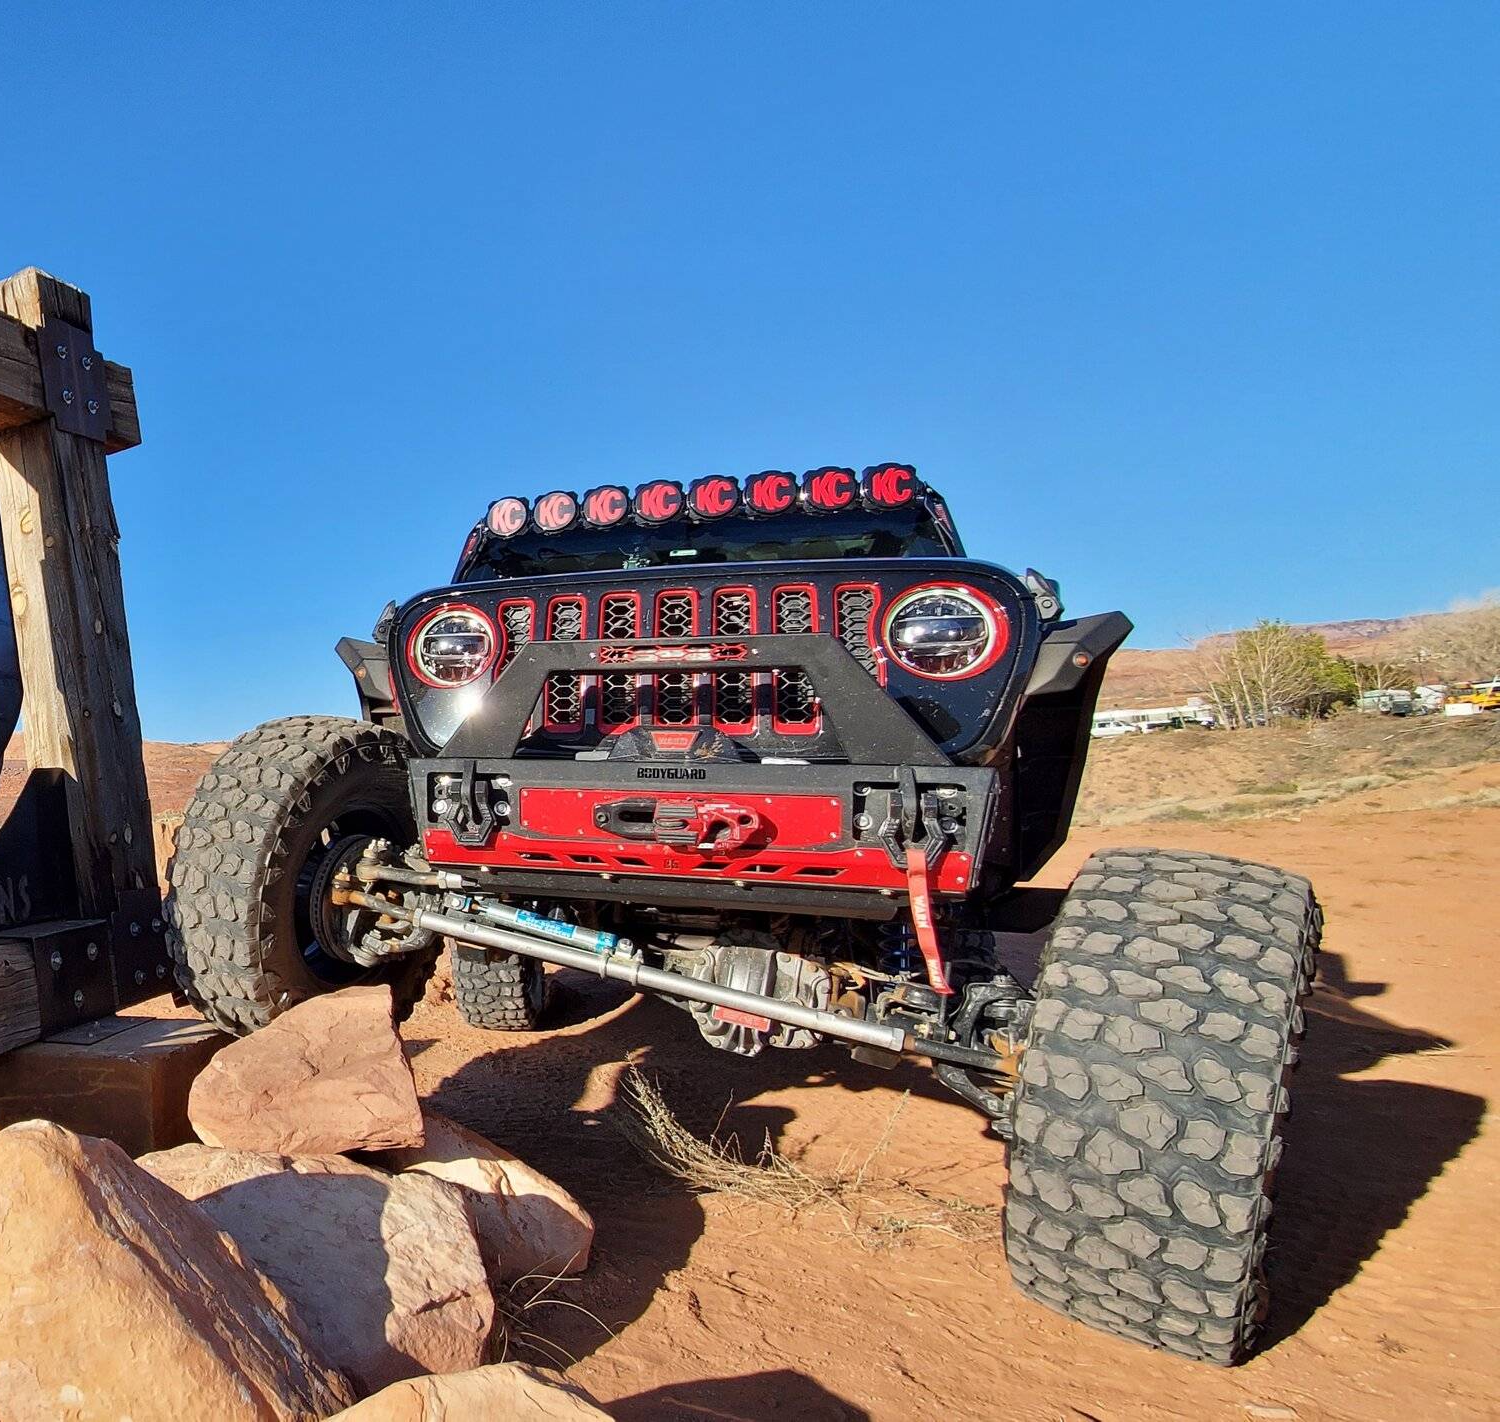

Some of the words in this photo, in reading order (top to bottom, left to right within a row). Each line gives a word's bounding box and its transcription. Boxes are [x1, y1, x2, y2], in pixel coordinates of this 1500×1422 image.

[641, 483, 678, 519] KC
[696, 479, 733, 514] KC
[753, 475, 790, 511] KC
[812, 471, 851, 507] KC
[872, 467, 912, 504] KC
[492, 499, 522, 535] KC
[539, 494, 571, 528] KC
[589, 489, 623, 523] KC
[636, 767, 707, 780] BODYGUARD
